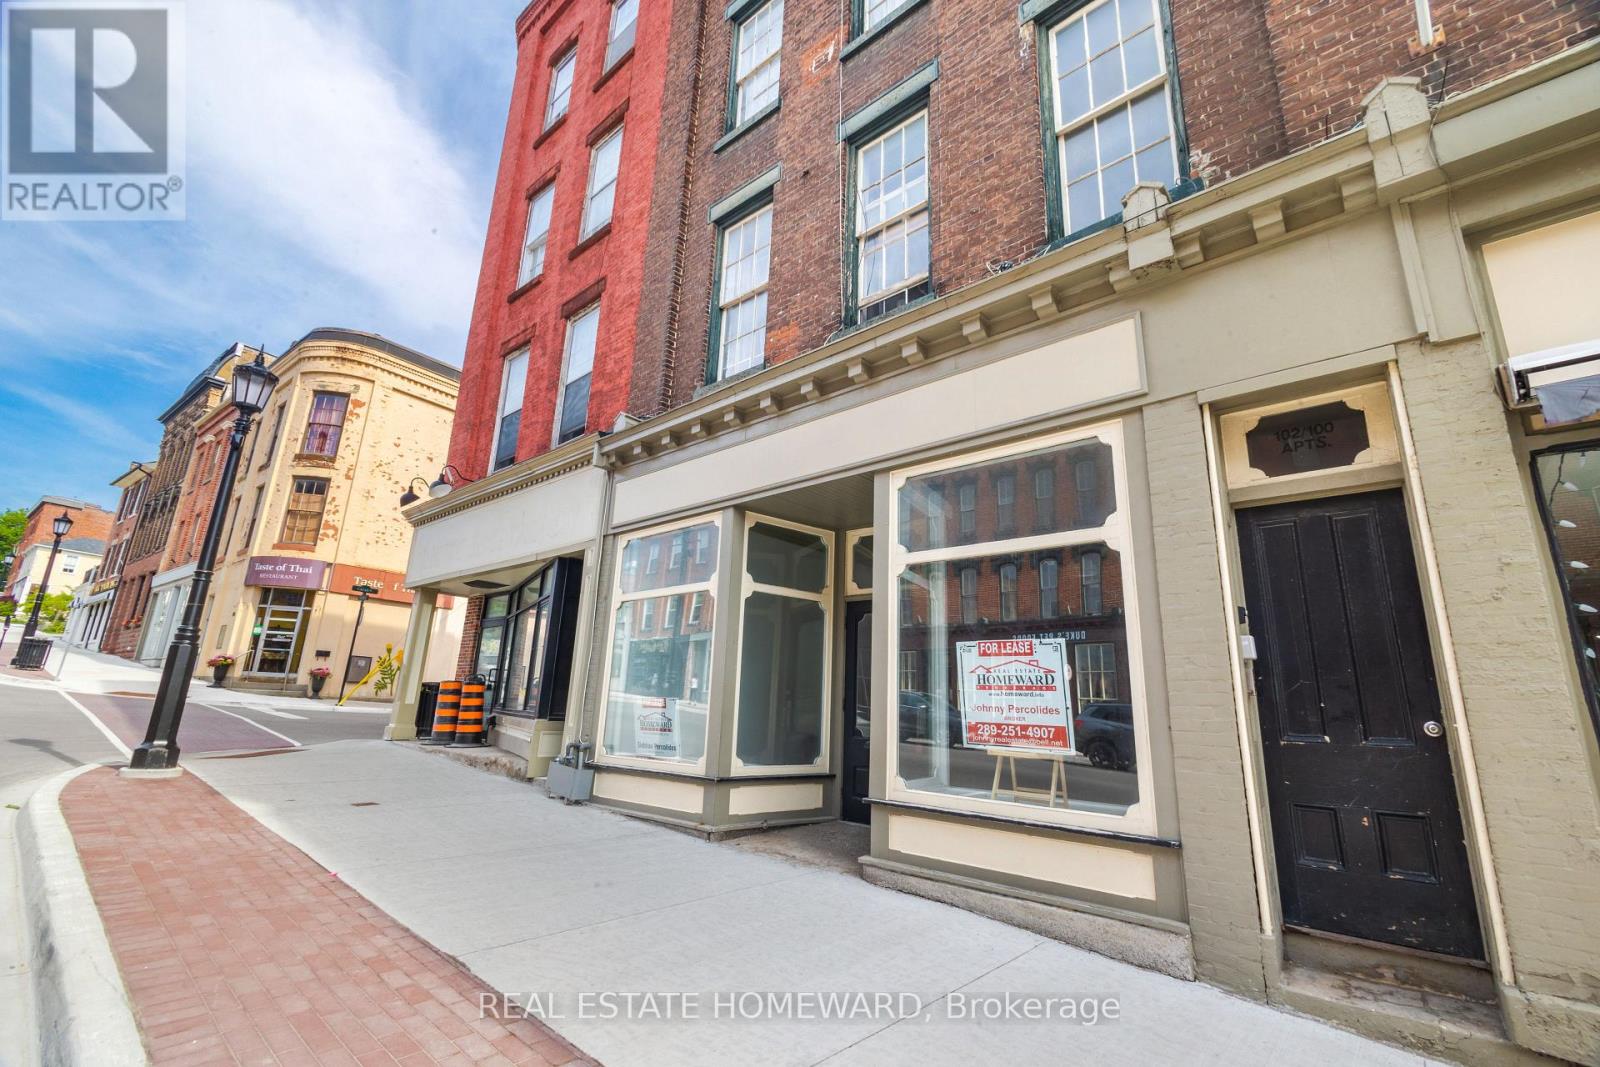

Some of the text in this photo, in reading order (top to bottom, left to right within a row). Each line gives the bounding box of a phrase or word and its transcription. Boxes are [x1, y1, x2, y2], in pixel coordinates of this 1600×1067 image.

[1274, 421, 1334, 441] 102/100
[1281, 435, 1332, 454] APTS.
[255, 563, 313, 574] Taste of Thai
[353, 575, 384, 589] Taste
[980, 643, 999, 654] FOR
[1001, 641, 1032, 654] LEASE
[977, 673, 1054, 685] HOMEWARD
[971, 704, 1061, 715] Johnny Percolides
[977, 723, 1056, 739] 289-251-4907
